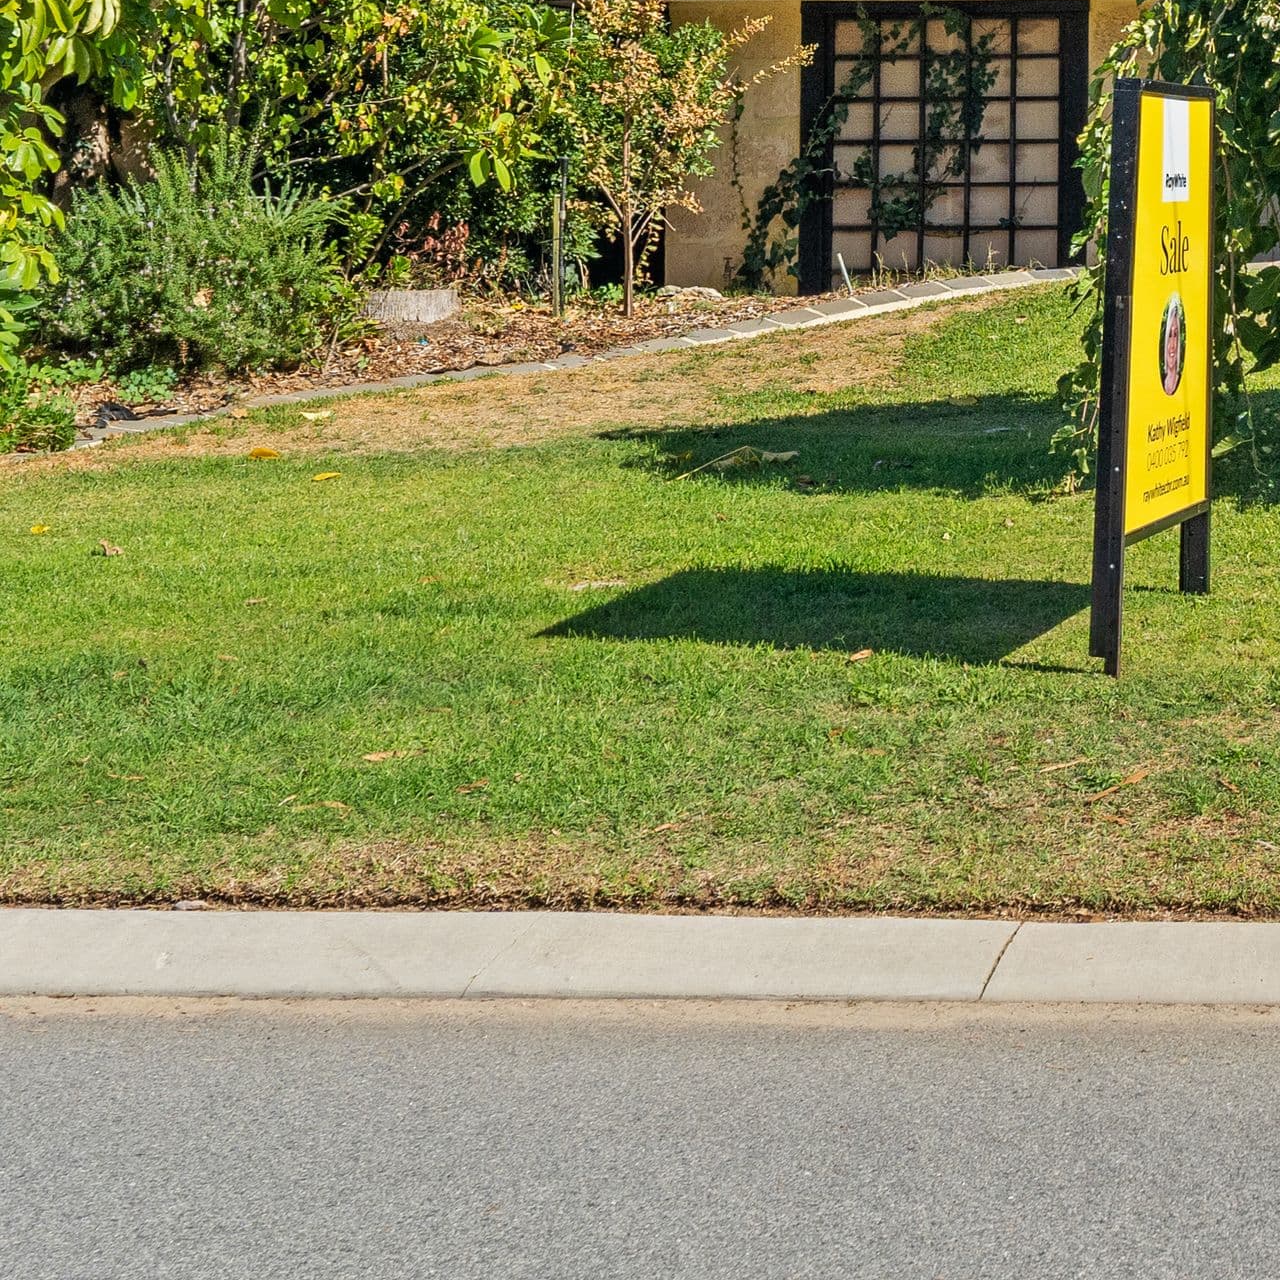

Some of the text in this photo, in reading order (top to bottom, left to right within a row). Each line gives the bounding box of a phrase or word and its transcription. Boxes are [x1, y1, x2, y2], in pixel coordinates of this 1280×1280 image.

[1160, 220, 1189, 276] Sale
[1147, 410, 1190, 443] Kathy Wigfield
